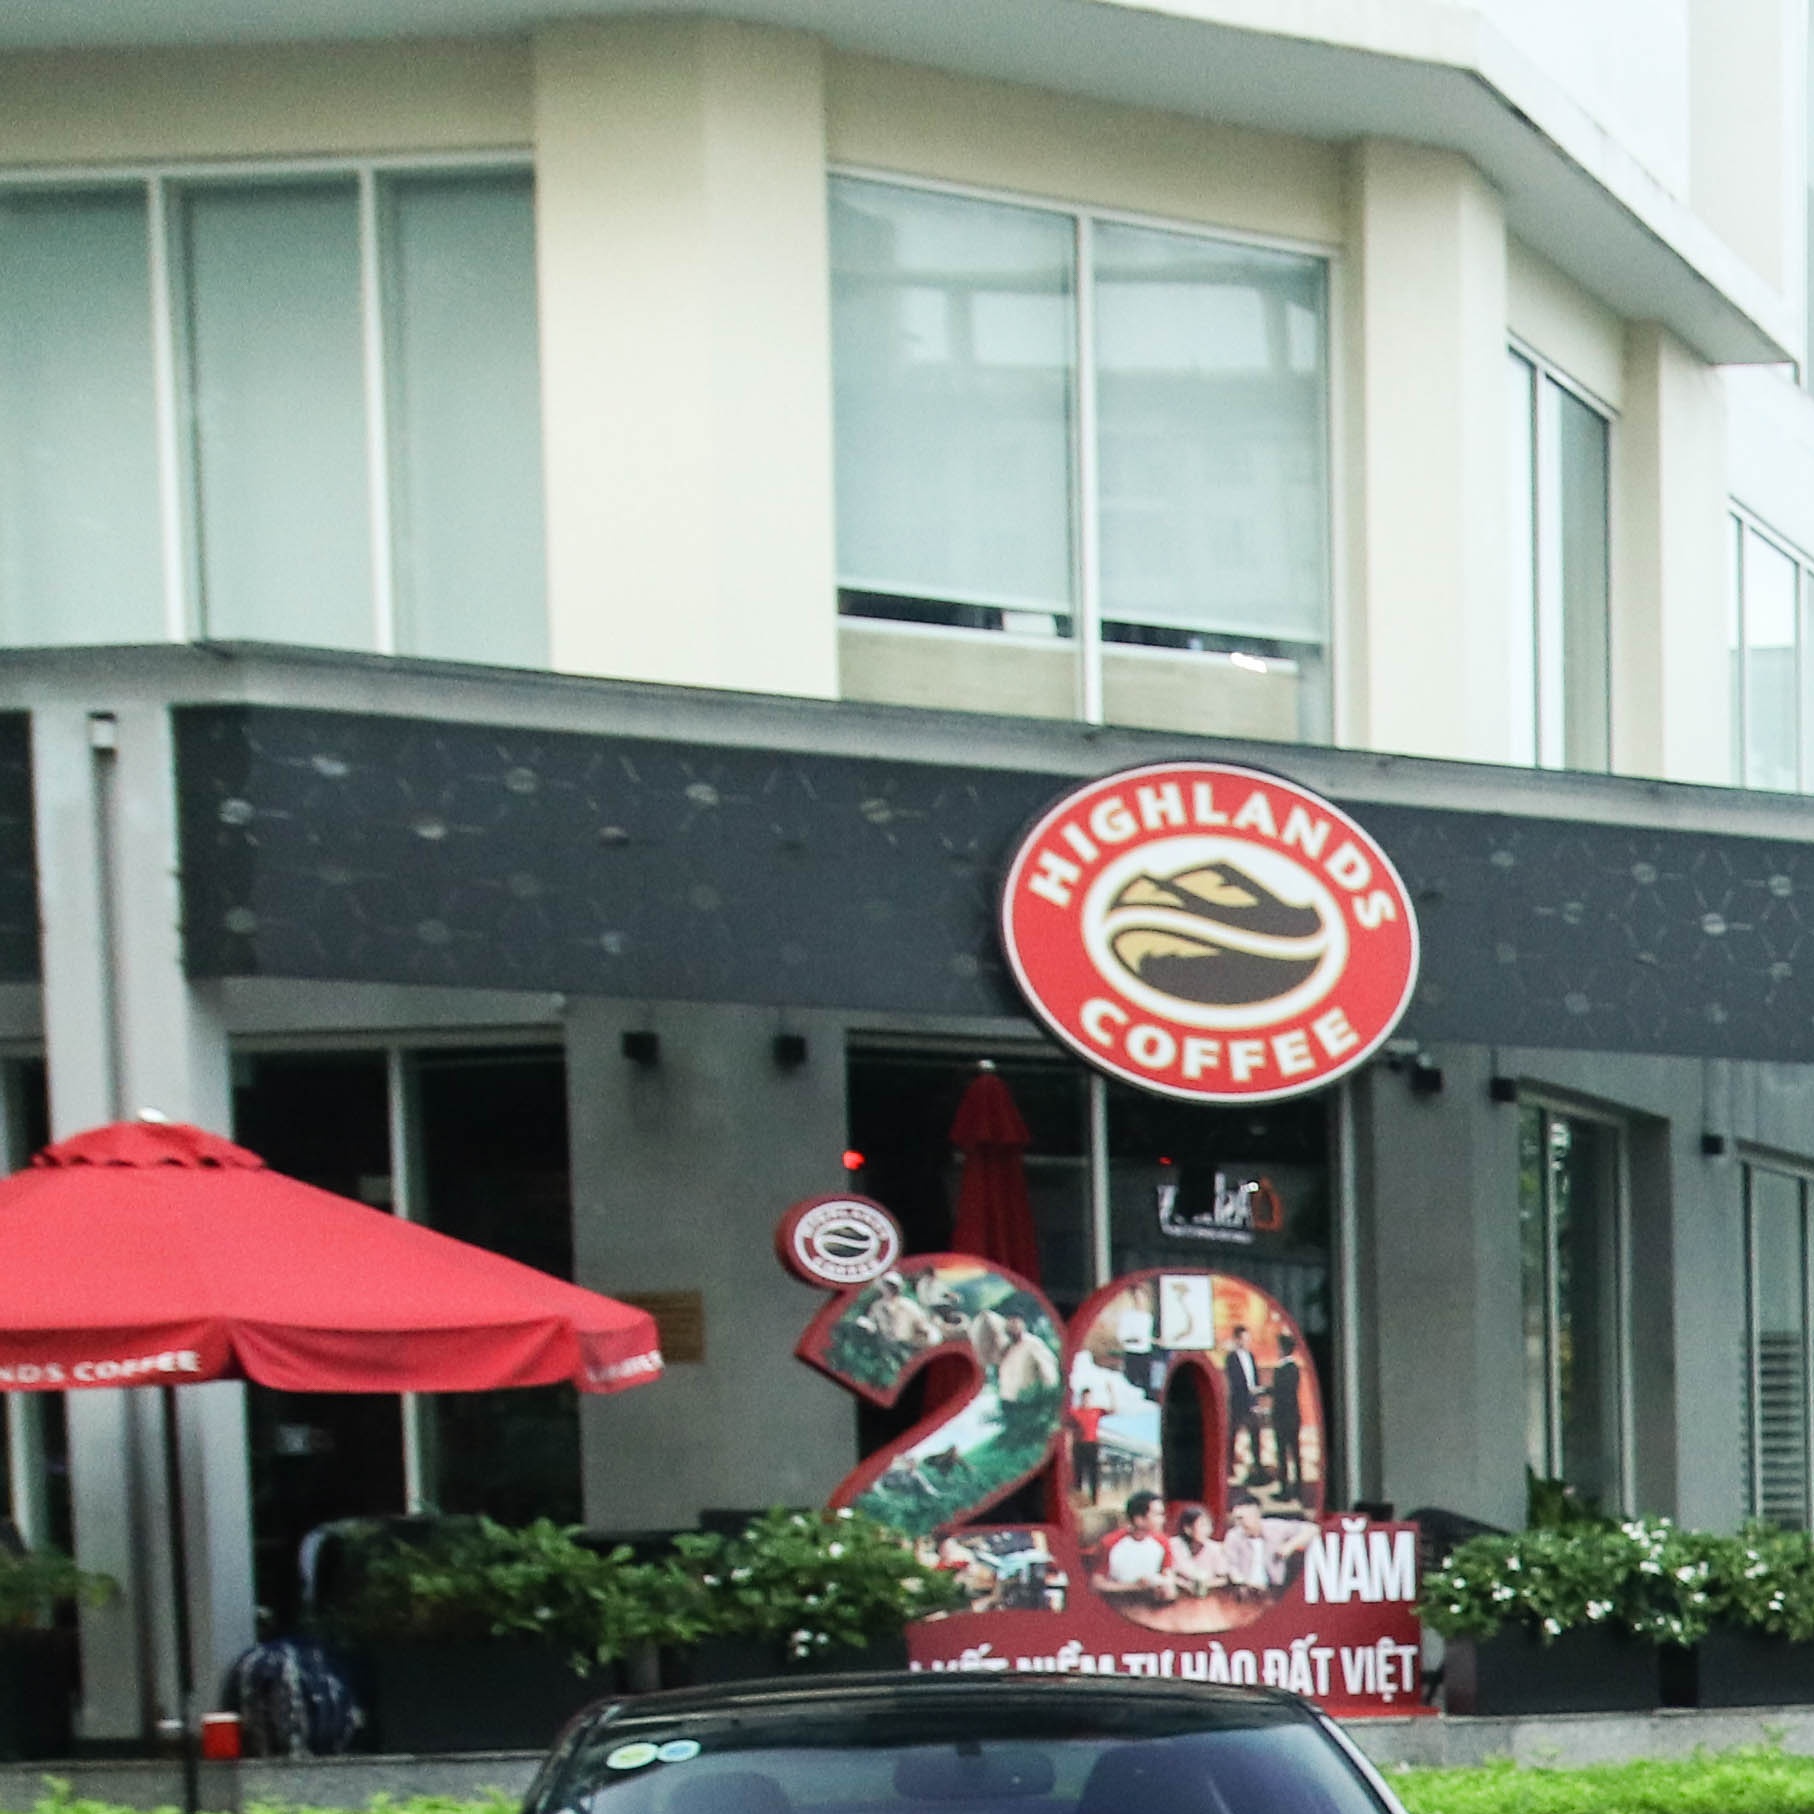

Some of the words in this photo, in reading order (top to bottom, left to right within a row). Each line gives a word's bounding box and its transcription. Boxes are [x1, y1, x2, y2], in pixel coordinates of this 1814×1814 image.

[1027, 781, 1397, 930] HIGHLANDS
[1078, 997, 1360, 1082] COFFEE
[1304, 1517, 1416, 1604] NĂM
[1340, 1636, 1418, 1703] VIỆT
